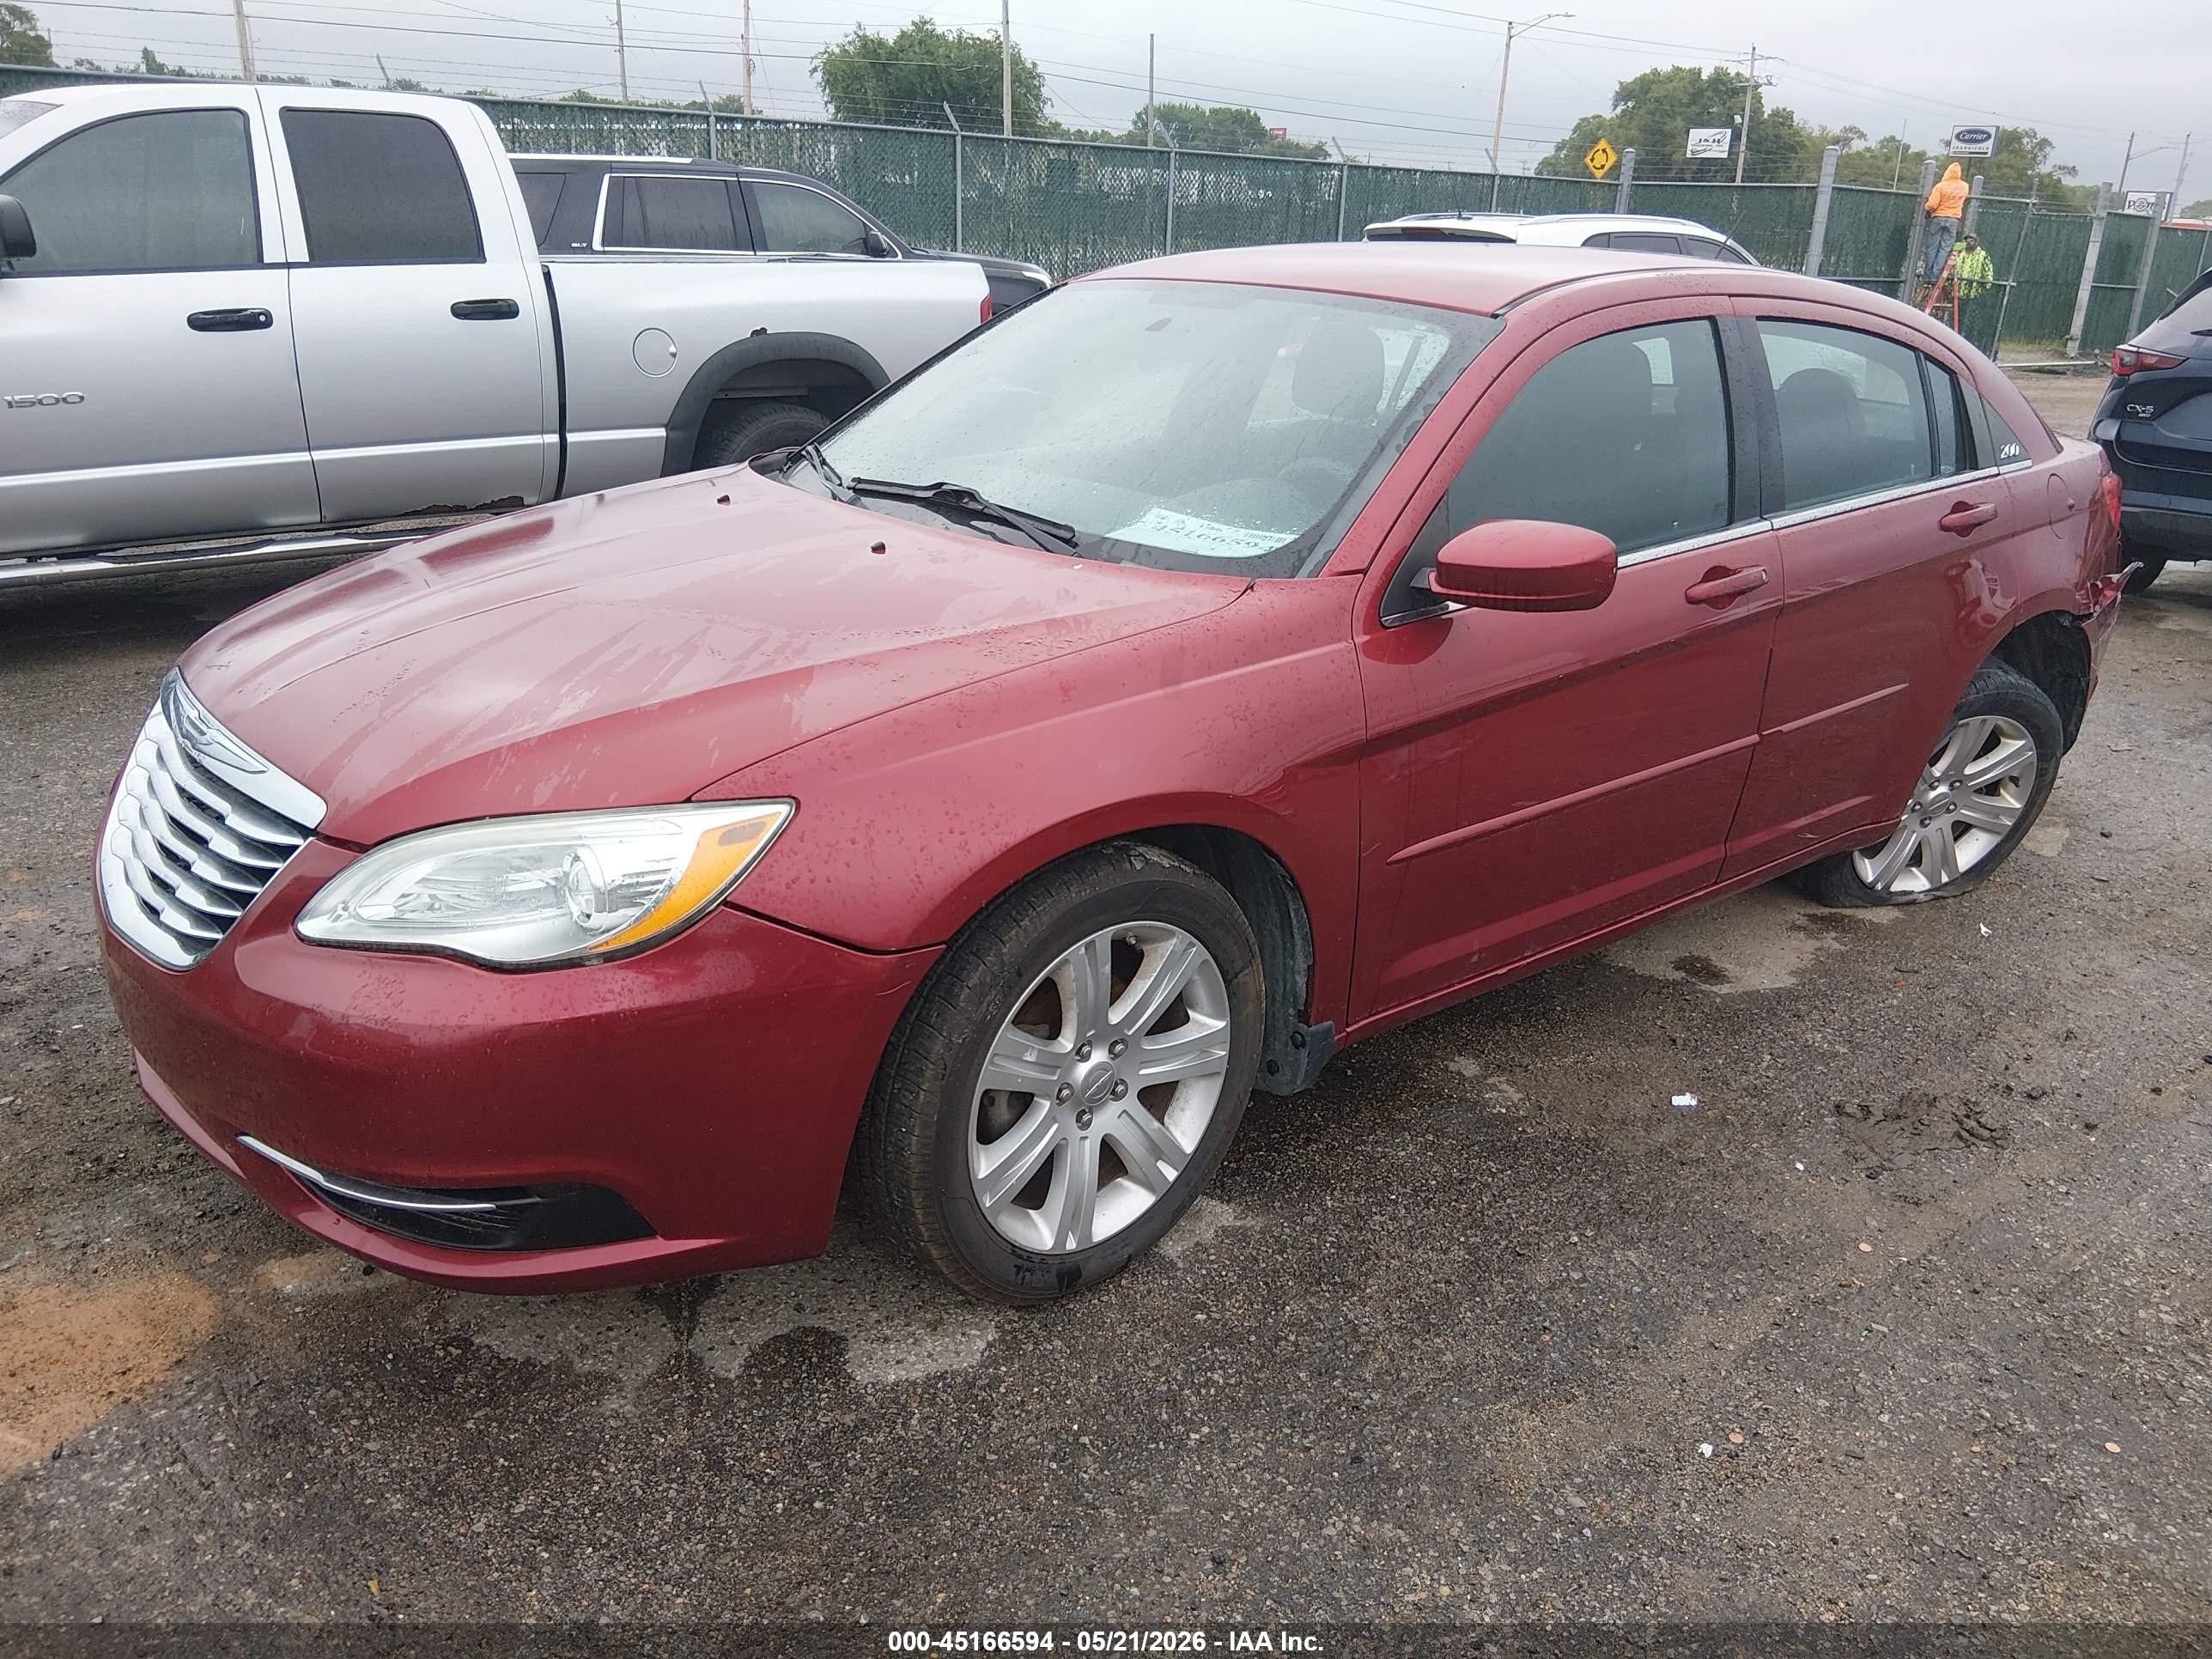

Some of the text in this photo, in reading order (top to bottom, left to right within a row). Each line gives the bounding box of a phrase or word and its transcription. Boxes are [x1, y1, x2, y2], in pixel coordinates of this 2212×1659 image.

[1960, 131, 1988, 140] Carrier
[3, 391, 85, 409] 1500
[2126, 404, 2154, 414] CX-5
[2000, 443, 2020, 459] 200
